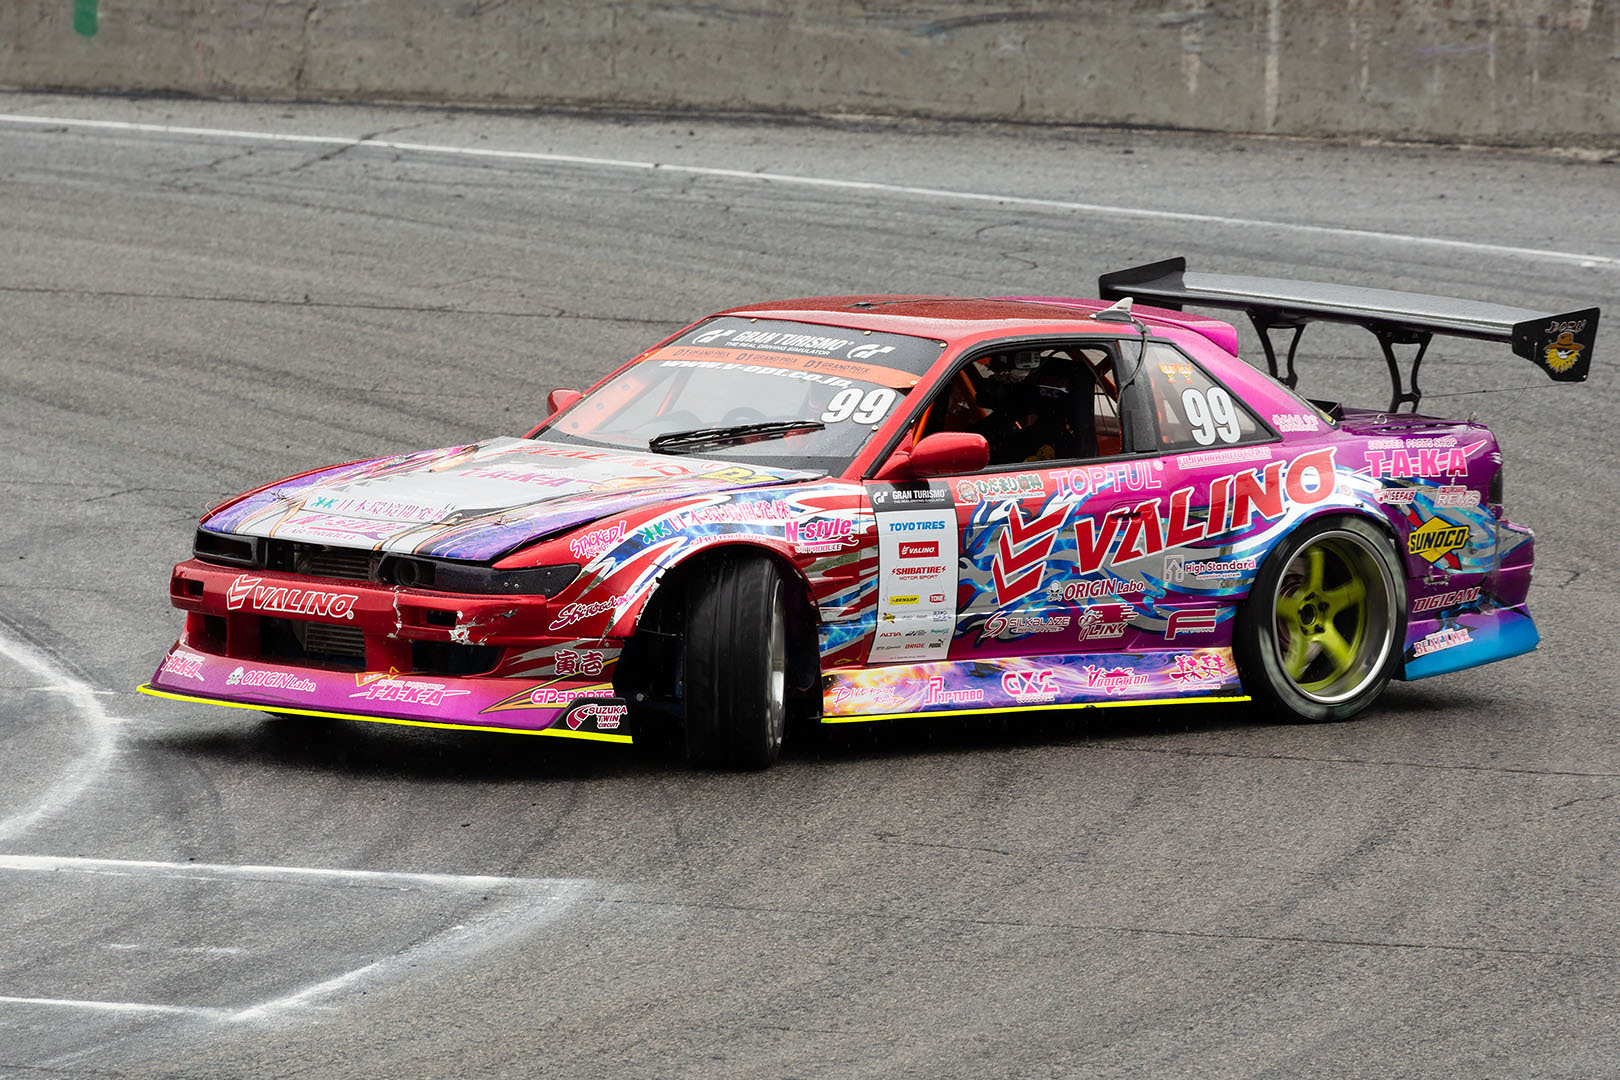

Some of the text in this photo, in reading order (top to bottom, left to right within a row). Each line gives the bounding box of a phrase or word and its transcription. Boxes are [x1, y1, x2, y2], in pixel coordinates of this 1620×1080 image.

[732, 331, 849, 351] GRAN TURISMO
[759, 343, 786, 351] DRIVING
[787, 346, 830, 356] SIMULATOR
[672, 349, 689, 357] D1
[735, 352, 798, 364] D1 GRAND PRIX
[803, 359, 870, 374] D1 GRAND PRIX
[820, 388, 897, 424] 99
[1182, 386, 1242, 446] 99
[1049, 462, 1162, 497] TOPTUL
[892, 490, 945, 500] GRAN TURISMO
[1074, 446, 1337, 574] VALINO
[785, 518, 852, 542] N-style
[889, 521, 945, 531] TOYO TIRES
[1408, 526, 1469, 554] SUNOCO
[896, 566, 940, 575] SHIBATIRE
[1185, 559, 1256, 574] High Standard
[1063, 578, 1117, 600] ORIGIN
[253, 586, 357, 619] VALINO
[1412, 587, 1480, 613] DIGICAM
[1009, 617, 1071, 627] SILKBLAZE
[555, 649, 604, 676] 寅壱
[241, 670, 291, 690] ORIGIN
[588, 705, 627, 715] SUZUKA
[597, 715, 620, 723] TWIN
